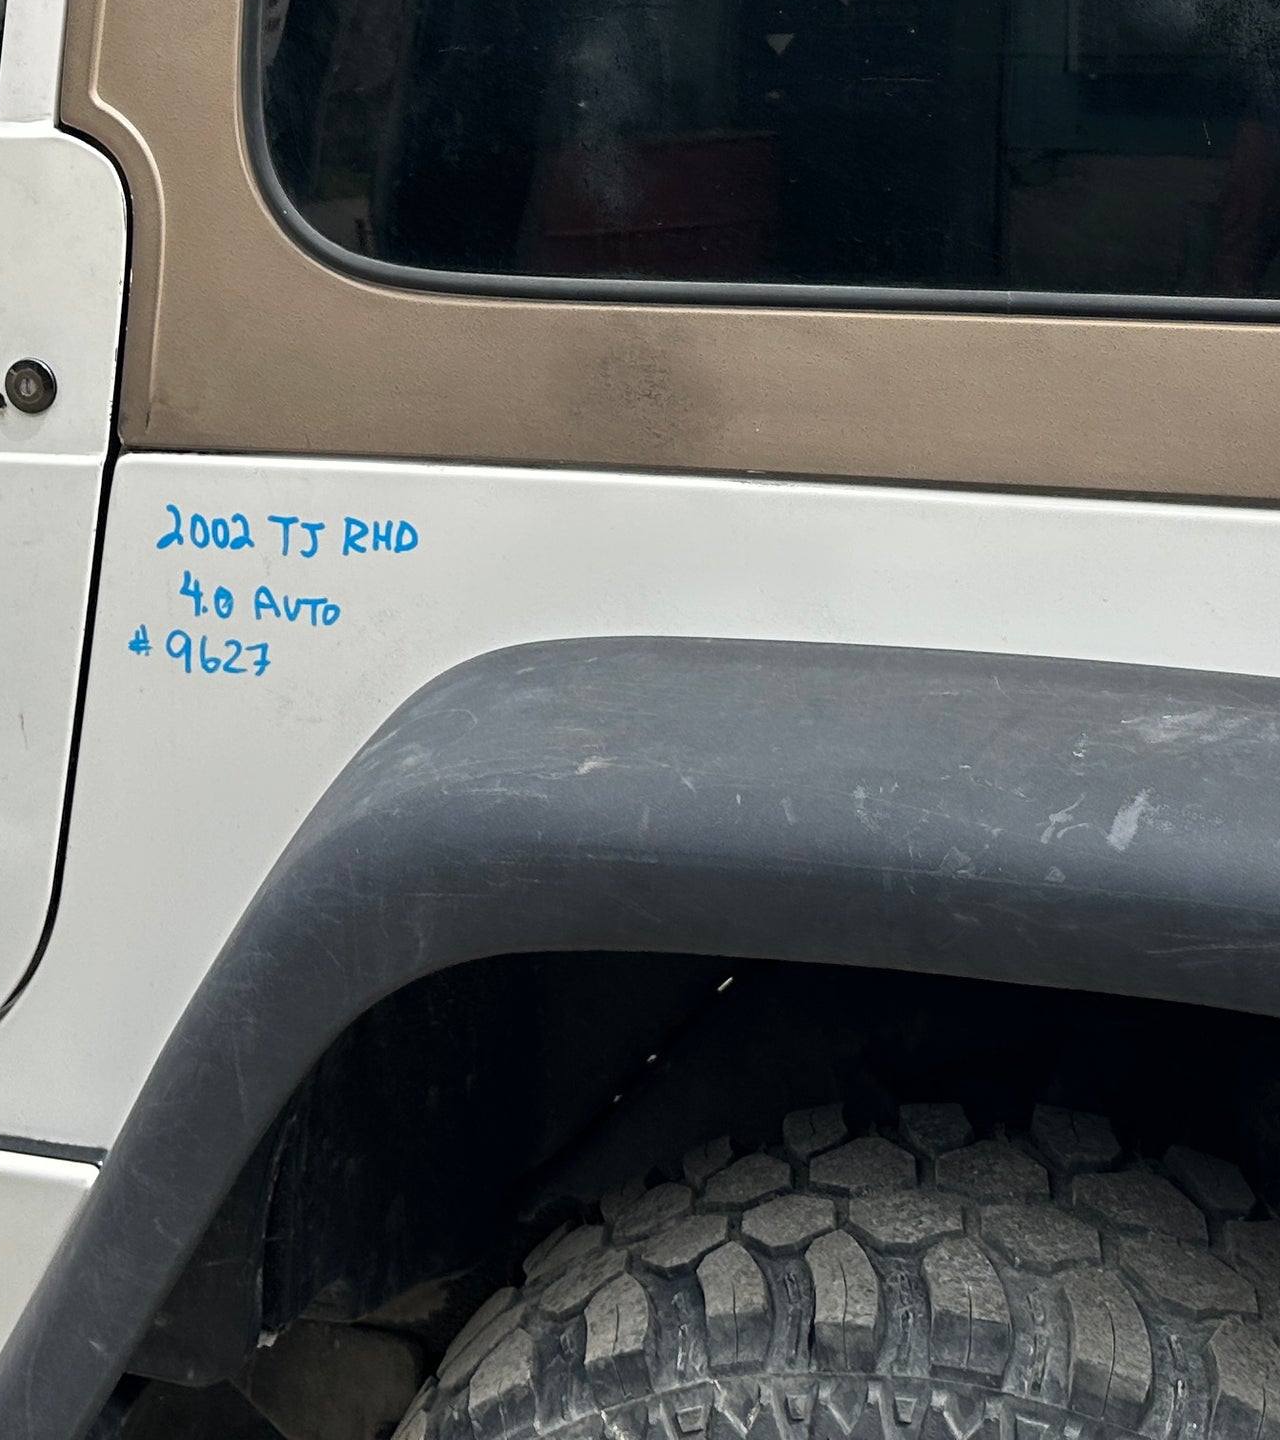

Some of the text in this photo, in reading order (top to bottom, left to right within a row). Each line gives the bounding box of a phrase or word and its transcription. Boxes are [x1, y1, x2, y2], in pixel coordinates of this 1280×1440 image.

[156, 504, 418, 558] 2002 TJ RHD
[179, 570, 341, 626] 4.0 AUTO
[165, 629, 270, 677] 9627
